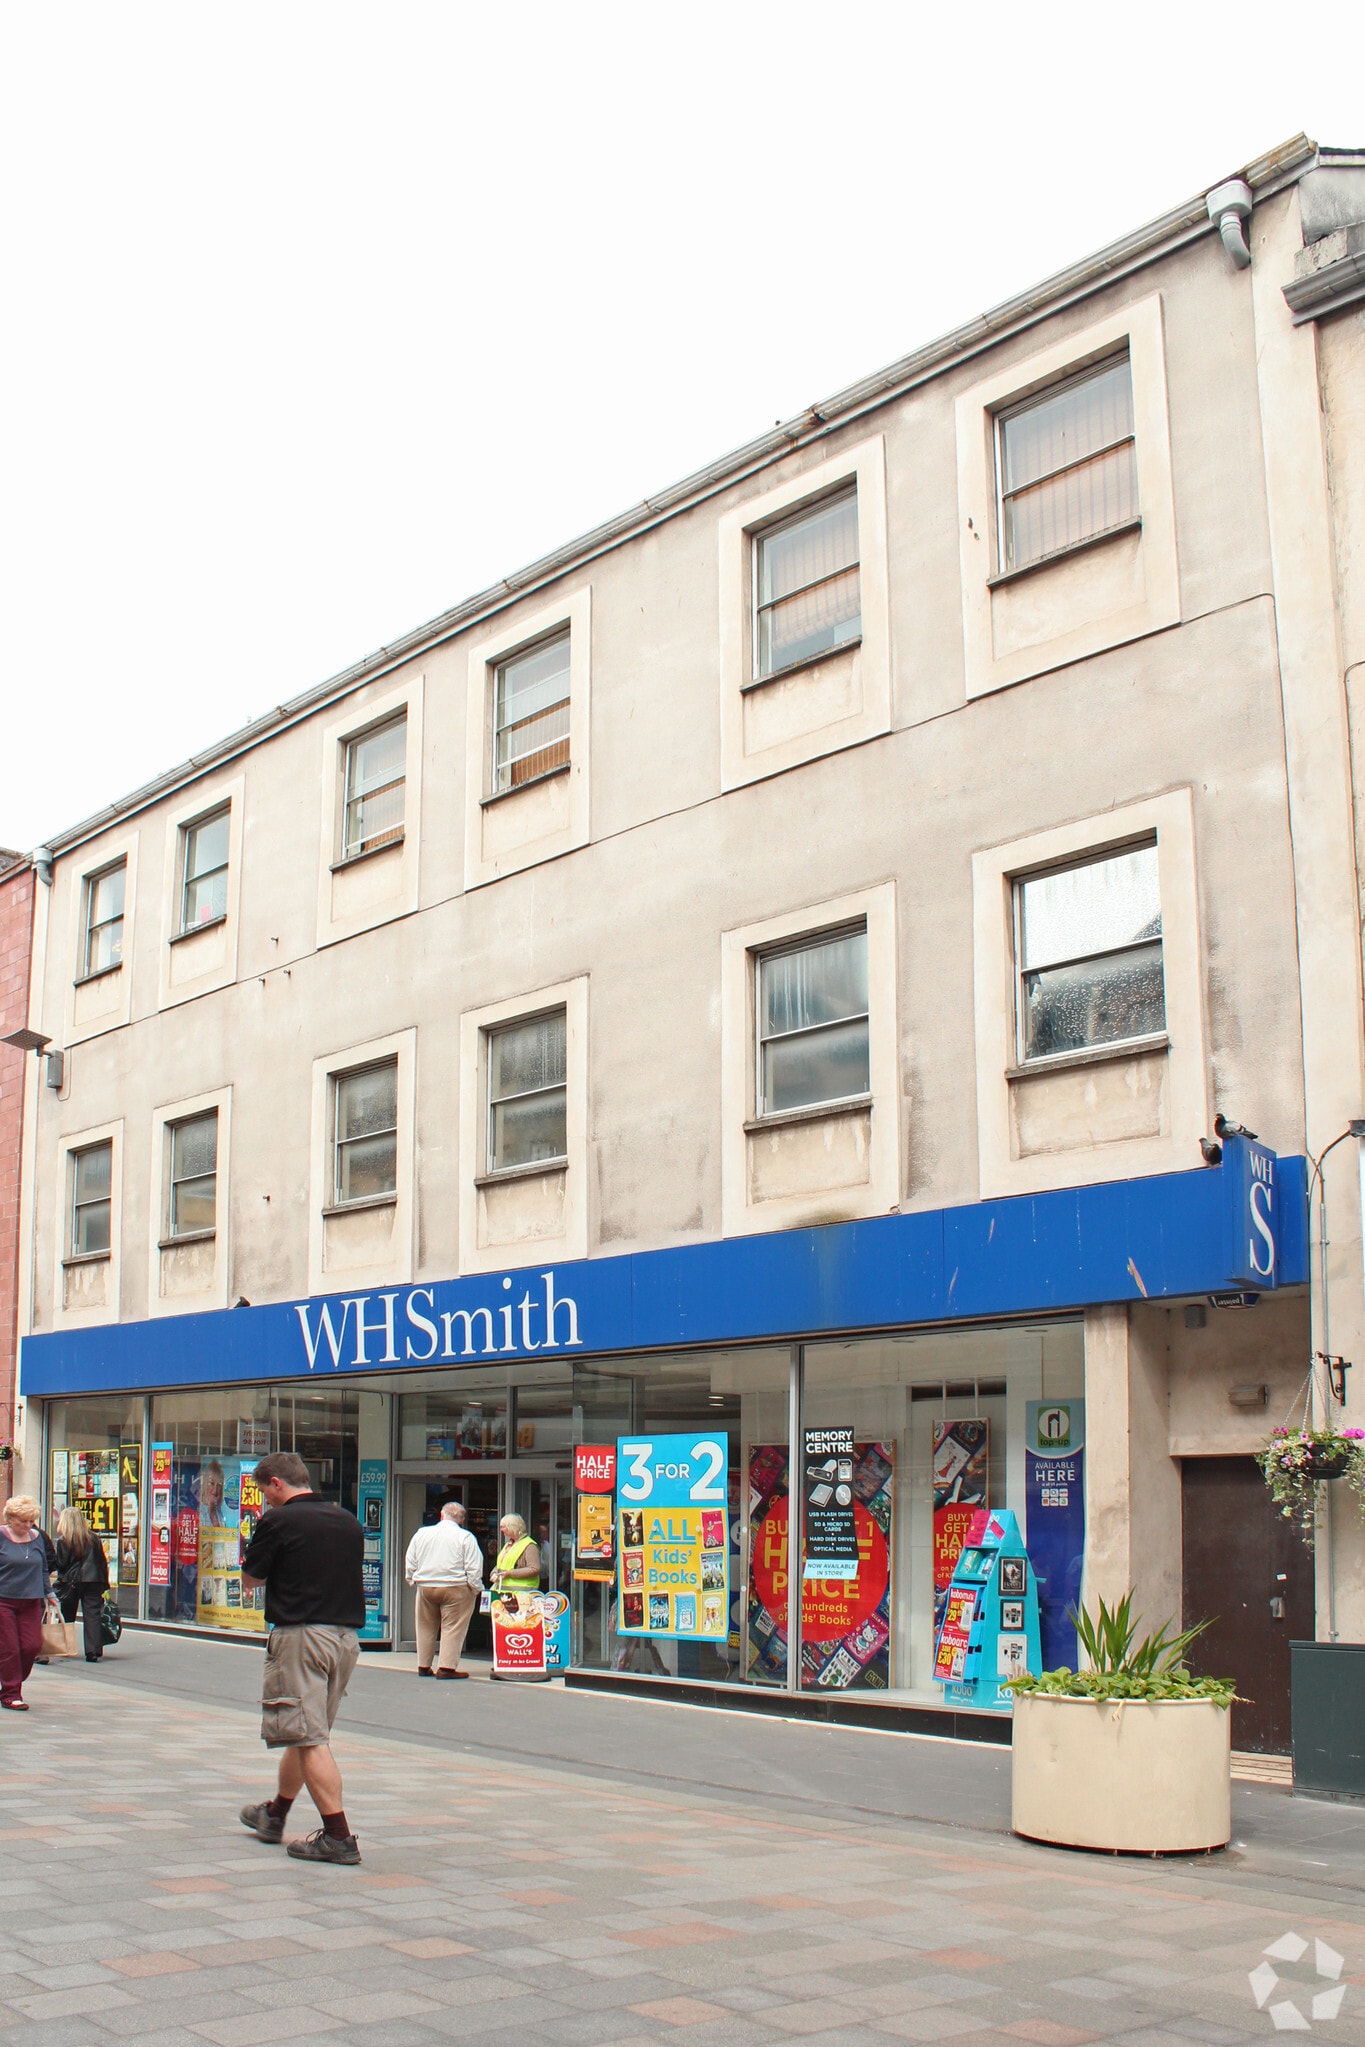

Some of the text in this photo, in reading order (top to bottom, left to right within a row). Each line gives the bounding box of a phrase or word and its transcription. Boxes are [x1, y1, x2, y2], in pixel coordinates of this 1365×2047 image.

[1249, 1151, 1274, 1185] WH
[1249, 1181, 1275, 1276] S
[294, 1271, 584, 1370] WHSmith
[805, 1431, 852, 1442] MEMORY
[806, 1442, 853, 1453] CENTRE
[1041, 1439, 1069, 1447] top-up
[576, 1456, 614, 1468] HALF
[580, 1469, 611, 1478] PRICE
[621, 1440, 725, 1500] 3 FOR 2
[1036, 1470, 1075, 1481] HERE
[361, 1472, 386, 1483] £59.99
[241, 1487, 262, 1505] £30
[93, 1498, 115, 1530] £1
[178, 1527, 198, 1537] HALF
[648, 1518, 696, 1541] ALL
[944, 1522, 969, 1532] GET
[180, 1536, 197, 1544] PRICE
[362, 1564, 380, 1575] Six
[648, 1568, 697, 1584] Books
